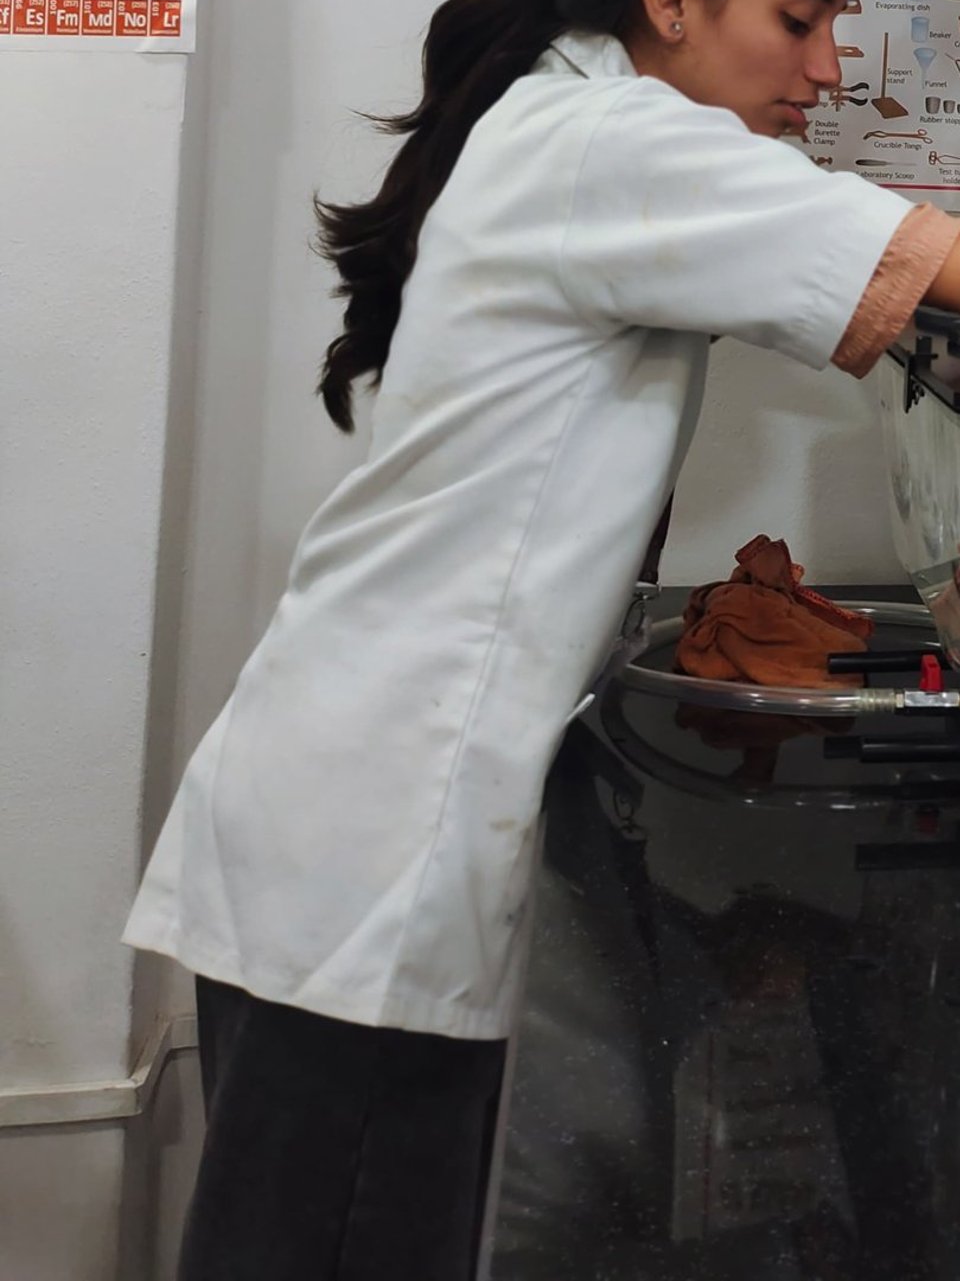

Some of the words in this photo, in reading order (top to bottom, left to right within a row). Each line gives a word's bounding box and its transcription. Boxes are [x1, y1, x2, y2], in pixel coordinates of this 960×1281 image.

[876, 2, 914, 11] Evaporating
[26, 9, 43, 25] Es
[57, 10, 78, 25] Fm
[89, 11, 112, 26] Md
[124, 12, 145, 27] No
[164, 14, 179, 27] Lr
[887, 69, 912, 77] Support
